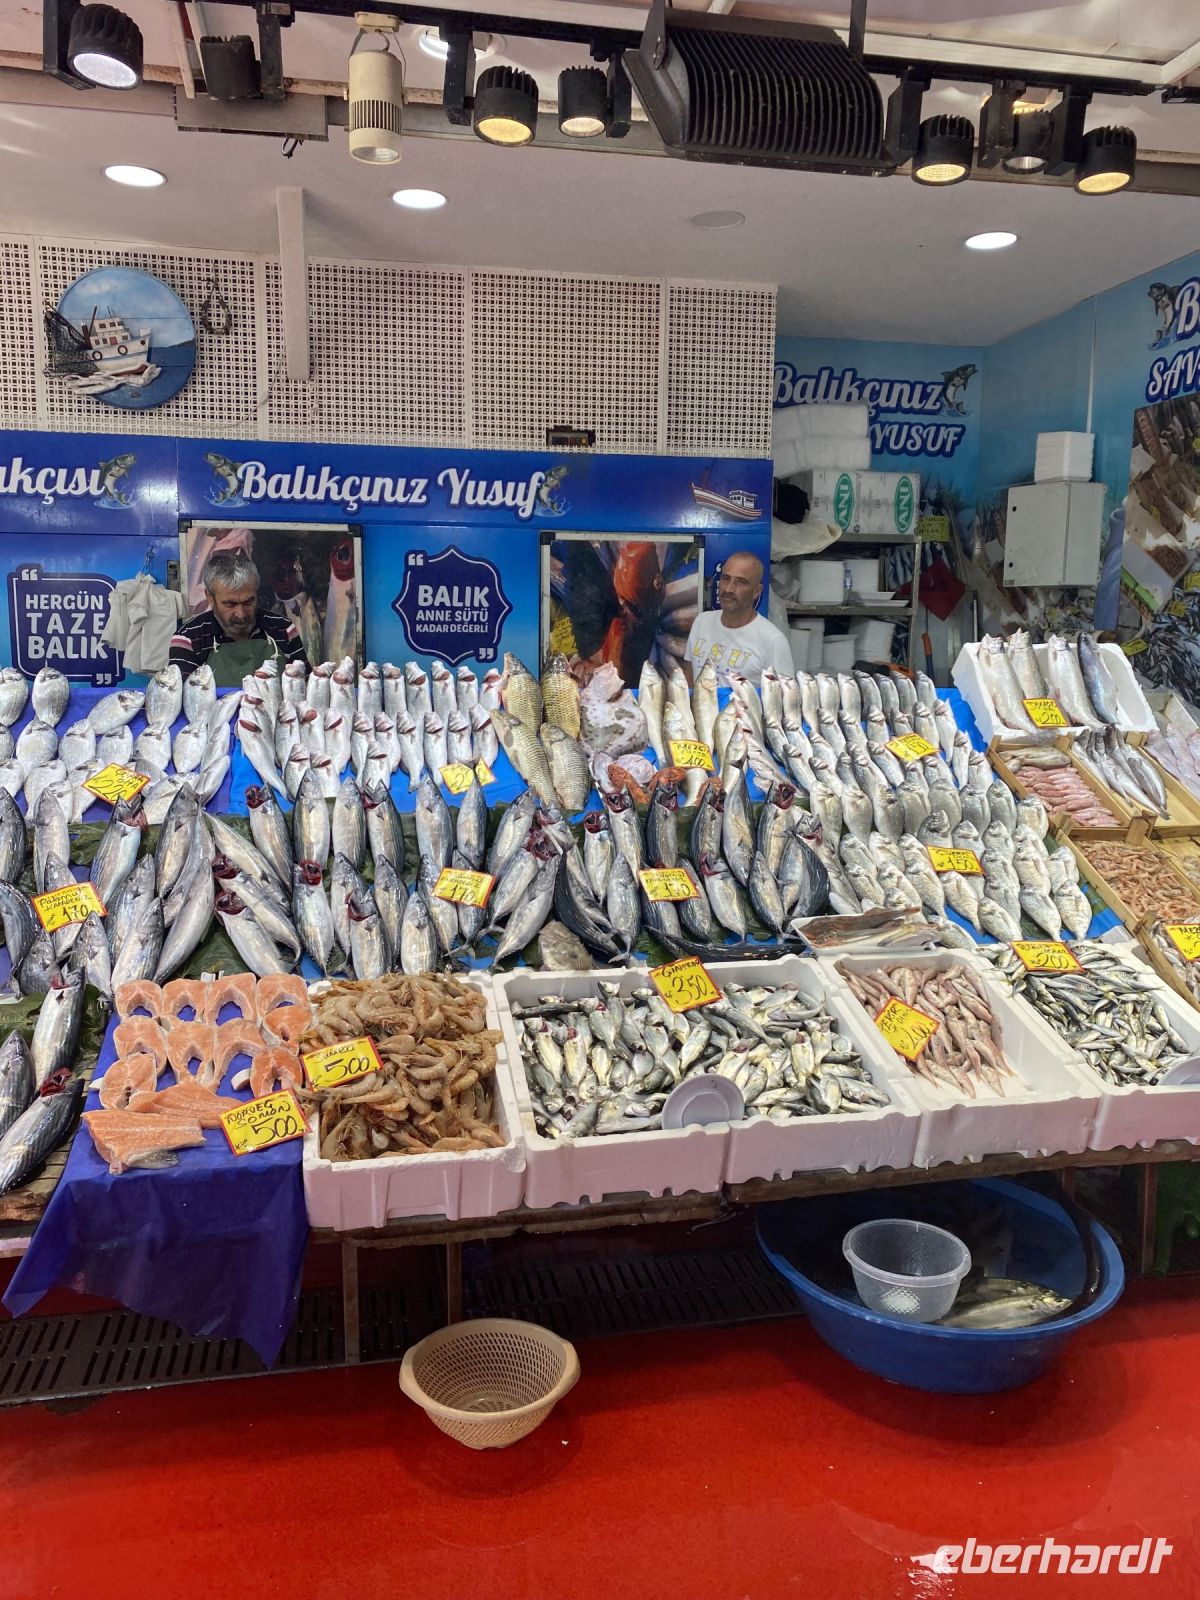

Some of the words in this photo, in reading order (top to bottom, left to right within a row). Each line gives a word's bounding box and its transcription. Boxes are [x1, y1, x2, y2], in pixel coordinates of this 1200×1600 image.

[1148, 349, 1200, 396] SAV
[774, 364, 943, 416] Balıkçınız
[869, 422, 962, 453] YUSUF
[237, 461, 427, 511] Balıkçınız
[437, 467, 545, 517] Yusuf
[26, 591, 103, 610] HERGÜN
[418, 584, 489, 608] BALIK
[26, 613, 105, 634] TAZE
[416, 609, 452, 622] ANNE
[454, 608, 488, 622] SÜTÜ
[416, 624, 448, 633] KADAR
[449, 622, 488, 633] DEĞERLİ
[28, 635, 108, 659] BALIK
[693, 638, 752, 669] LSU
[672, 974, 708, 1006] 350
[323, 1057, 370, 1083] 500
[251, 1115, 298, 1146] 500
